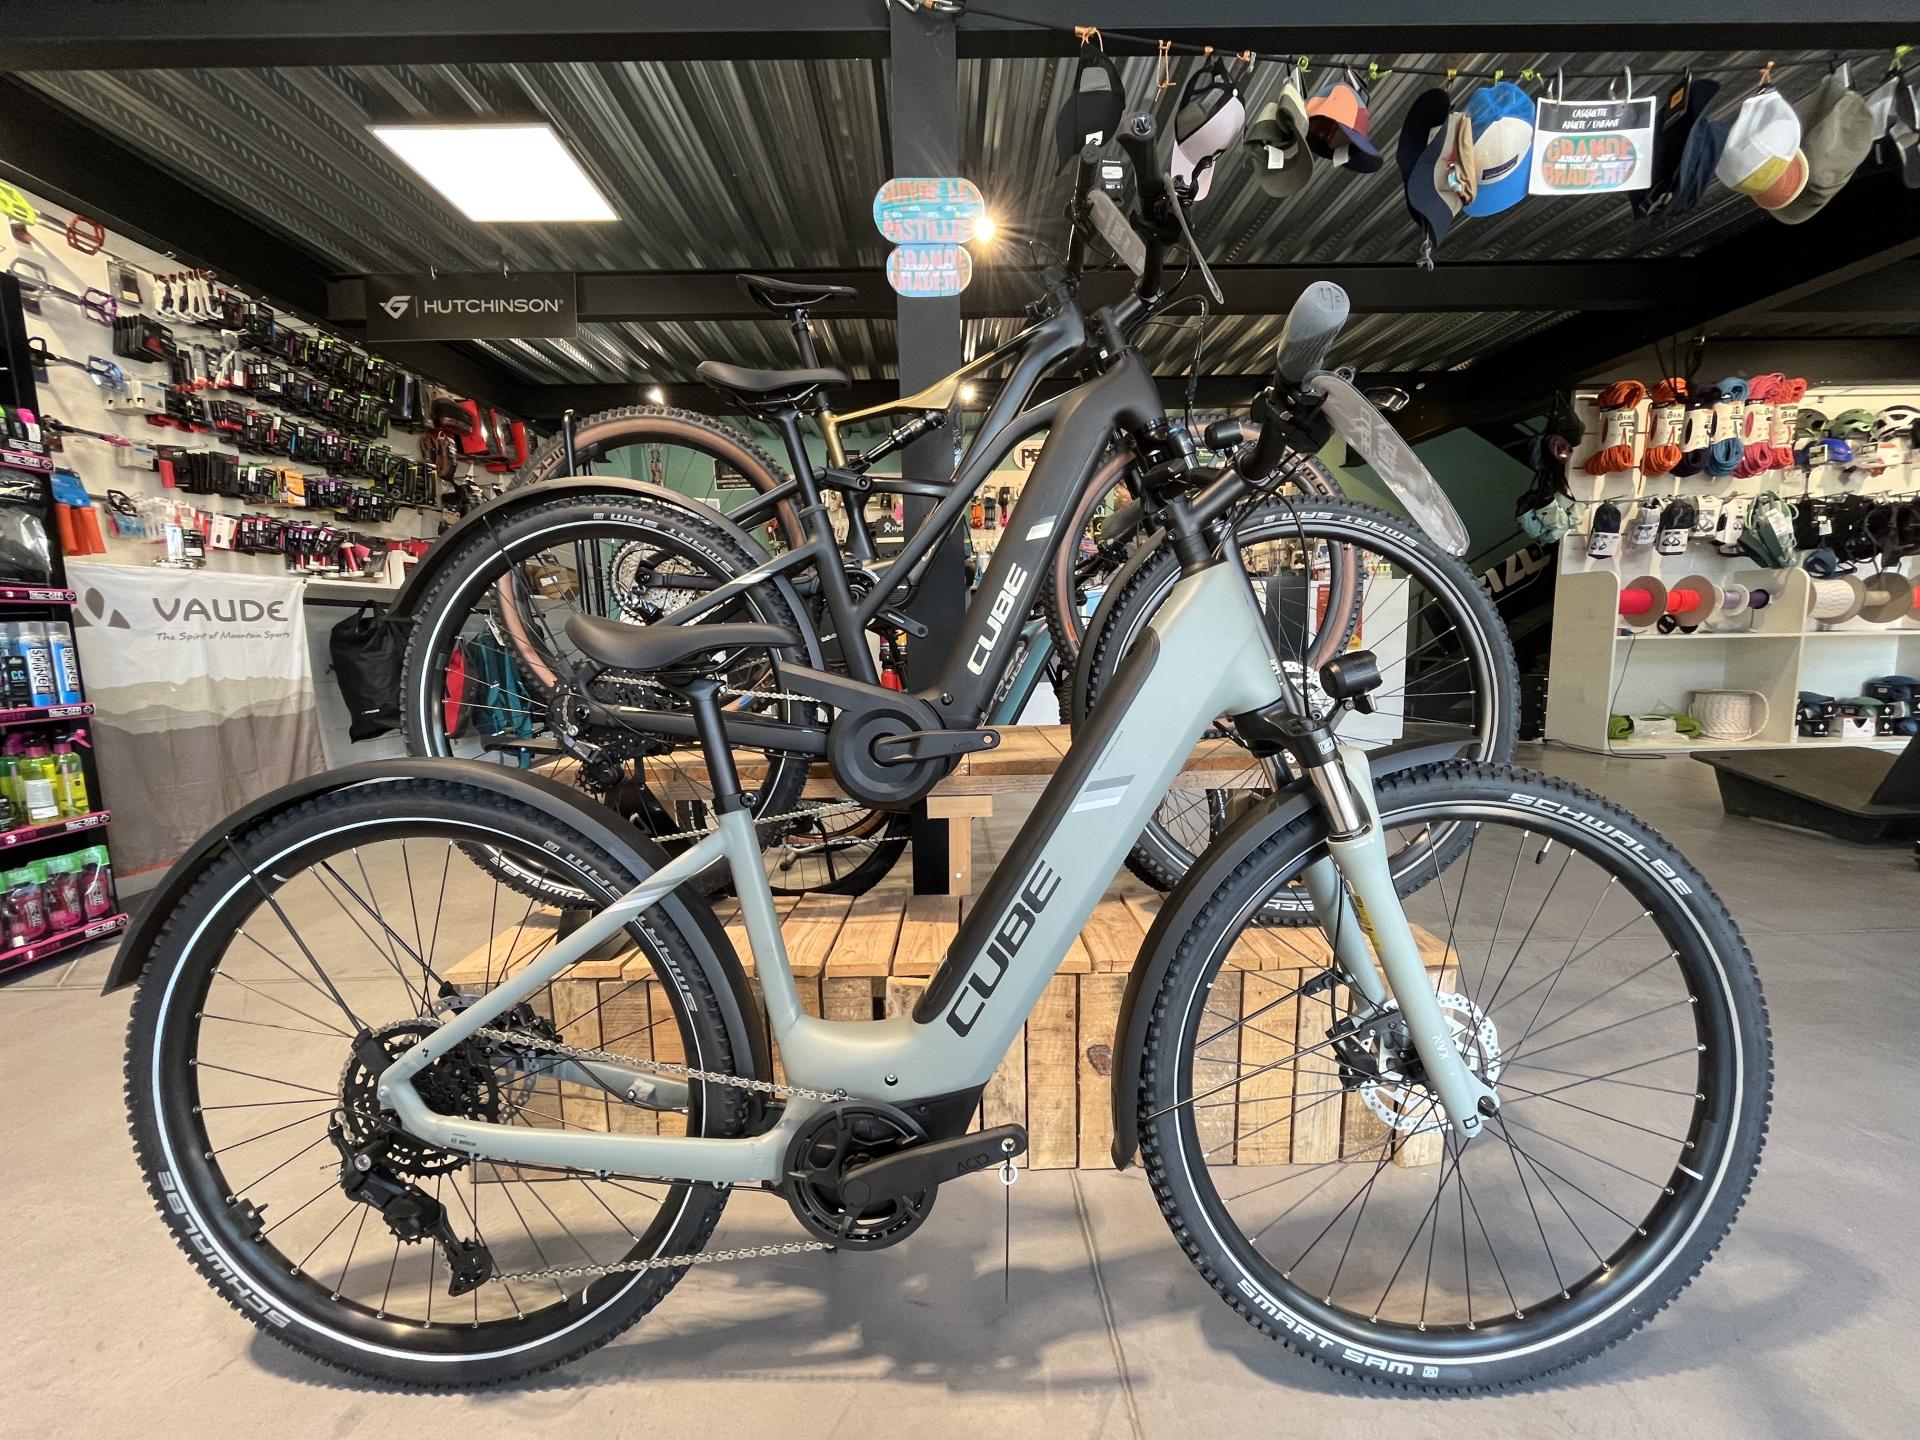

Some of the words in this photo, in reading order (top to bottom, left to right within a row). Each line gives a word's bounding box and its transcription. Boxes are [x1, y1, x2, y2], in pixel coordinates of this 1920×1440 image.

[1572, 108, 1608, 118] CASQUETTE
[1592, 118, 1620, 129] ENFANT
[423, 298, 559, 314] HUTCHINSON
[610, 513, 659, 529] SAM
[1339, 514, 1420, 548] SMART
[665, 528, 734, 573] SMART
[152, 597, 289, 622] VAUDE
[967, 562, 1028, 676] CUBE
[156, 632, 175, 642] The
[179, 631, 206, 643] Spirit
[209, 630, 218, 641] of
[220, 631, 261, 640] Mountain
[264, 631, 290, 640] Sports
[1508, 792, 1693, 896] SCHWALBE
[636, 915, 698, 1012] SMART
[946, 859, 1062, 1038] CUBE
[956, 1153, 992, 1174] ACID
[158, 1171, 292, 1328] SCHWALBE
[1237, 1277, 1334, 1349] SMART
[1342, 1348, 1414, 1376] SAM
